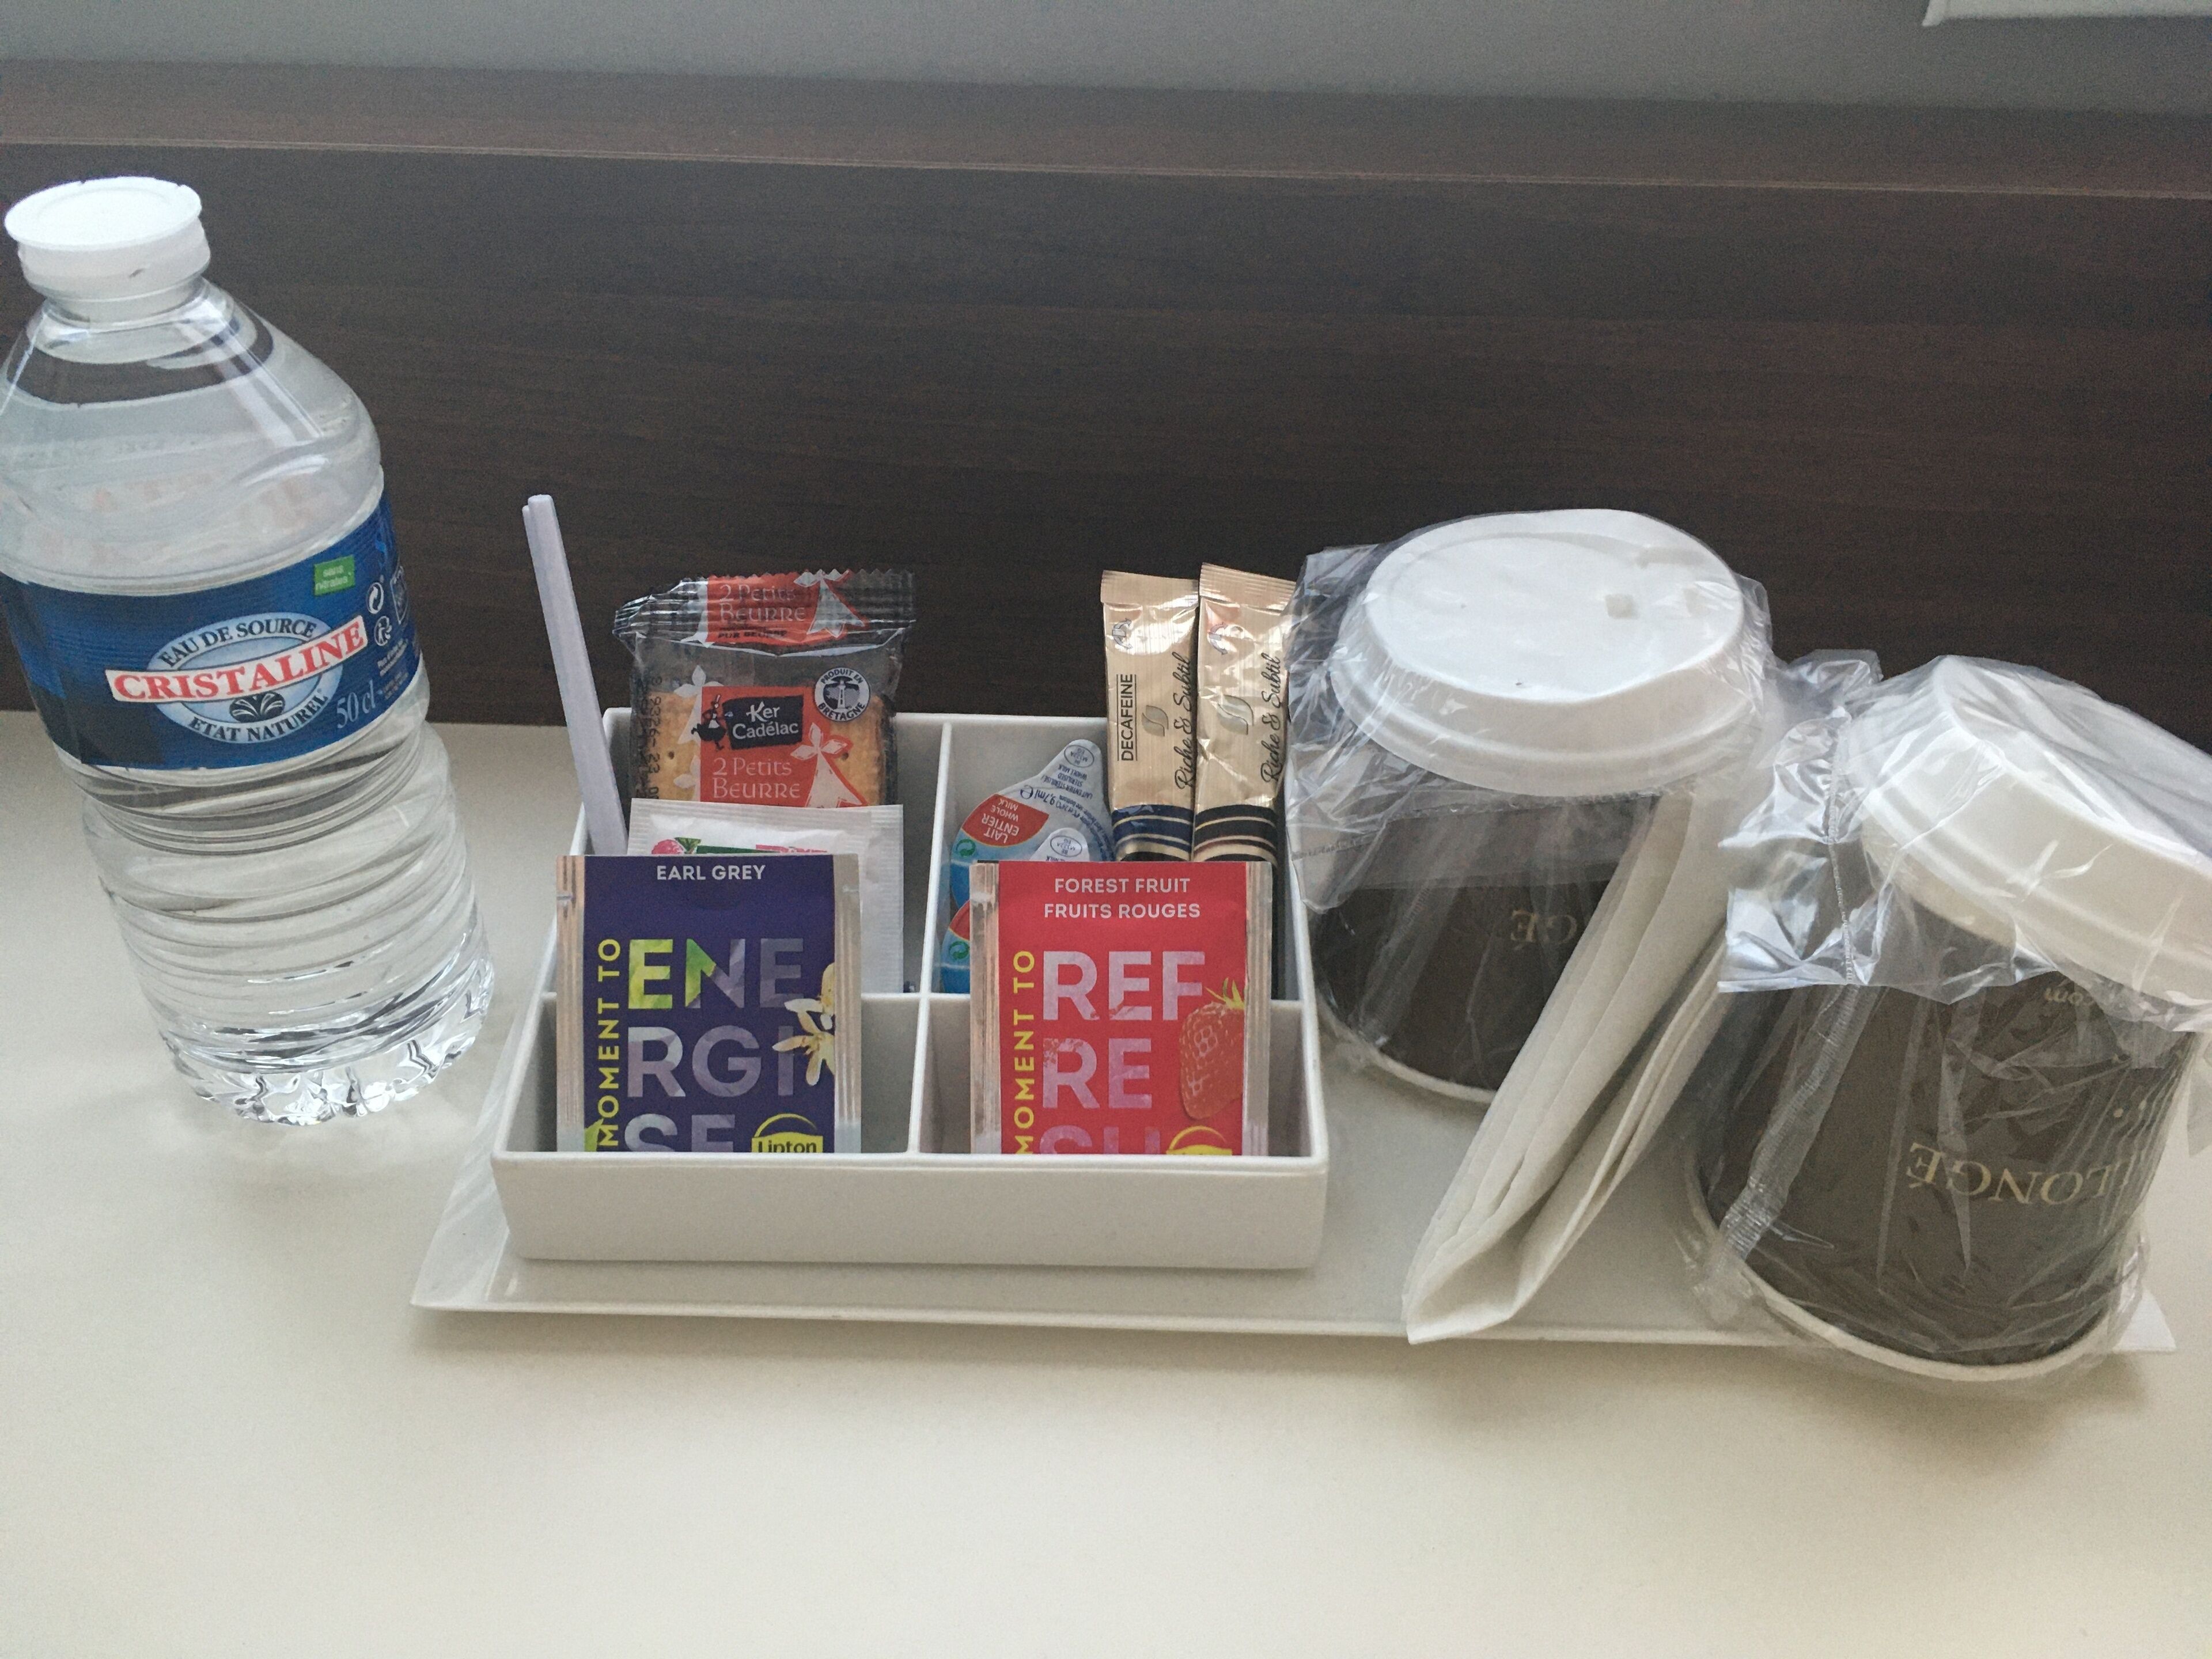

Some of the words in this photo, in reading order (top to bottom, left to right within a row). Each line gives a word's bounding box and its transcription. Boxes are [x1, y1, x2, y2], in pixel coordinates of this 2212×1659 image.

[720, 584, 734, 601] 2
[113, 622, 364, 699] CRISTALINE
[158, 635, 199, 668] EAU
[199, 626, 232, 647] DE
[236, 618, 316, 638] SOURCE
[821, 669, 853, 684] PRODUIT
[854, 675, 863, 684] EN
[1172, 652, 1192, 712] Subtil
[1261, 653, 1281, 709] Subtil
[188, 717, 240, 741] ETAT
[247, 693, 328, 741] NATUREL
[336, 692, 359, 729] 50
[746, 701, 780, 722] Ker
[818, 702, 865, 720] BRETAGNE
[1120, 674, 1134, 761] DECAFEINE
[1173, 717, 1192, 734] &
[1262, 713, 1281, 730] &
[732, 721, 799, 740] Cadélac
[713, 757, 727, 775] 2
[1174, 739, 1196, 790] Riche
[1260, 734, 1285, 782] Riche
[991, 805, 1018, 822] WHOLE
[998, 798, 1018, 811] MILK
[982, 813, 1019, 836] ENTIER
[983, 827, 1008, 843] LAIT
[657, 865, 706, 881] EARL
[712, 865, 766, 880] GREY
[1055, 878, 1129, 893] FOREST
[1135, 878, 1190, 893] FRUIT
[1044, 904, 1112, 919] FRUITS
[1118, 904, 1200, 919] ROUGES
[598, 939, 620, 982] TO
[628, 938, 804, 1009] ENE
[1013, 951, 1035, 993] TO
[1043, 951, 1205, 1021] REF
[597, 998, 620, 1147] MOMENT
[627, 1025, 794, 1097] RGI
[1043, 1037, 1152, 1108] RE
[1013, 1009, 1035, 1154] MOMENT
